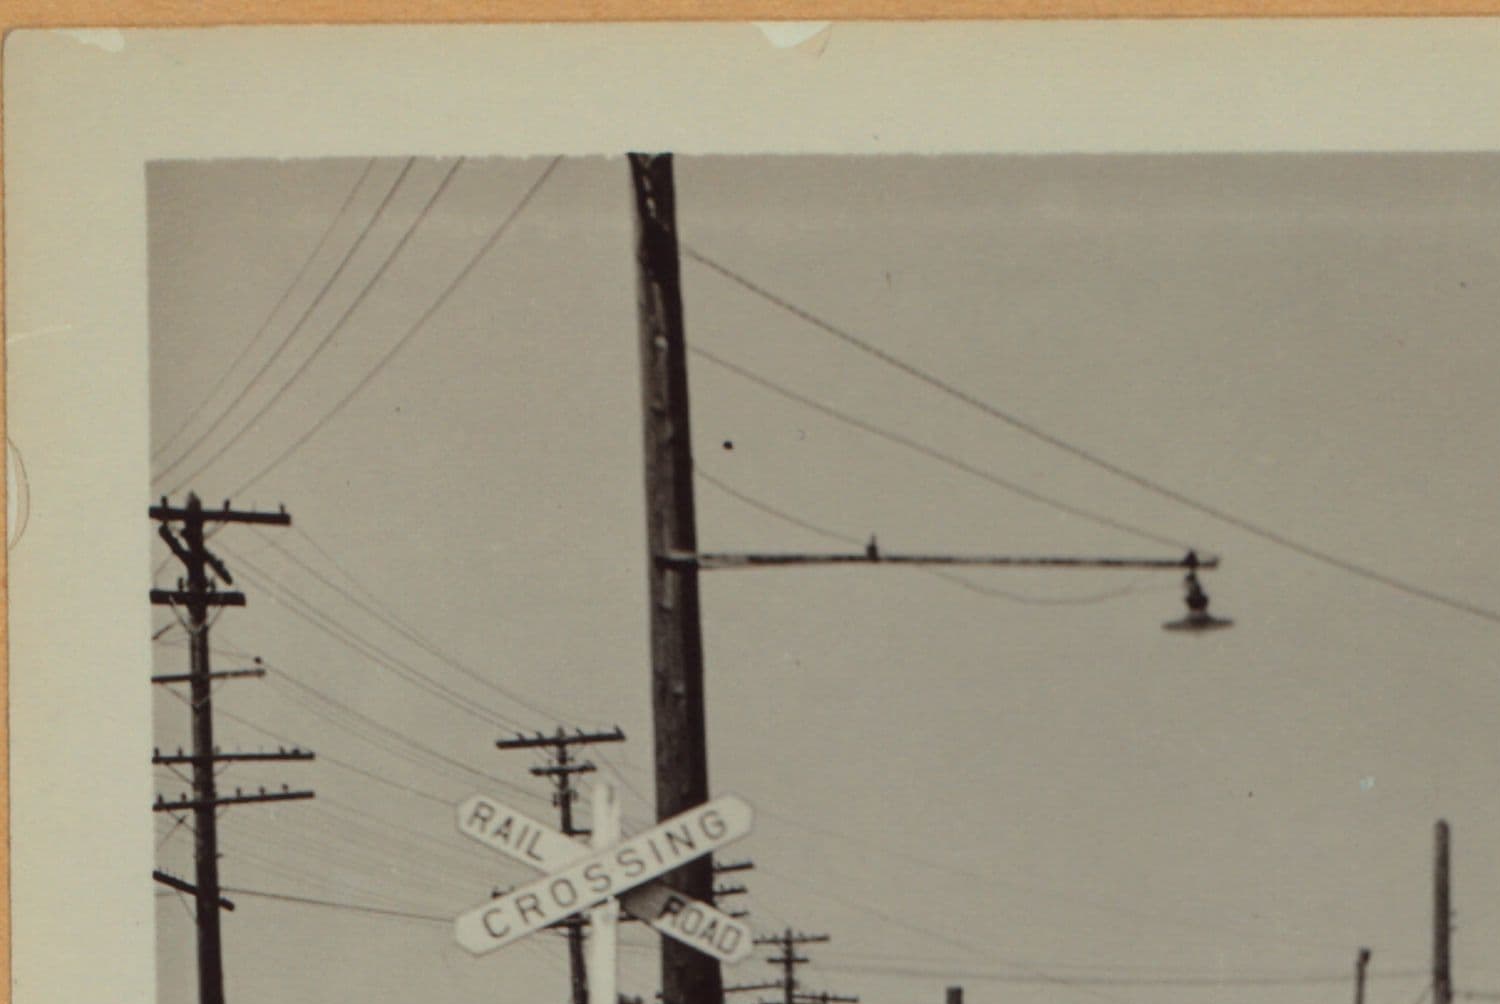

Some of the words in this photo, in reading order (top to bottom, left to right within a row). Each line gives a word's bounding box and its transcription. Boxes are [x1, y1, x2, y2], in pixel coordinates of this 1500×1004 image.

[468, 801, 543, 862] RAIL
[483, 811, 727, 938] CROSSING
[660, 896, 742, 955] ROAD
